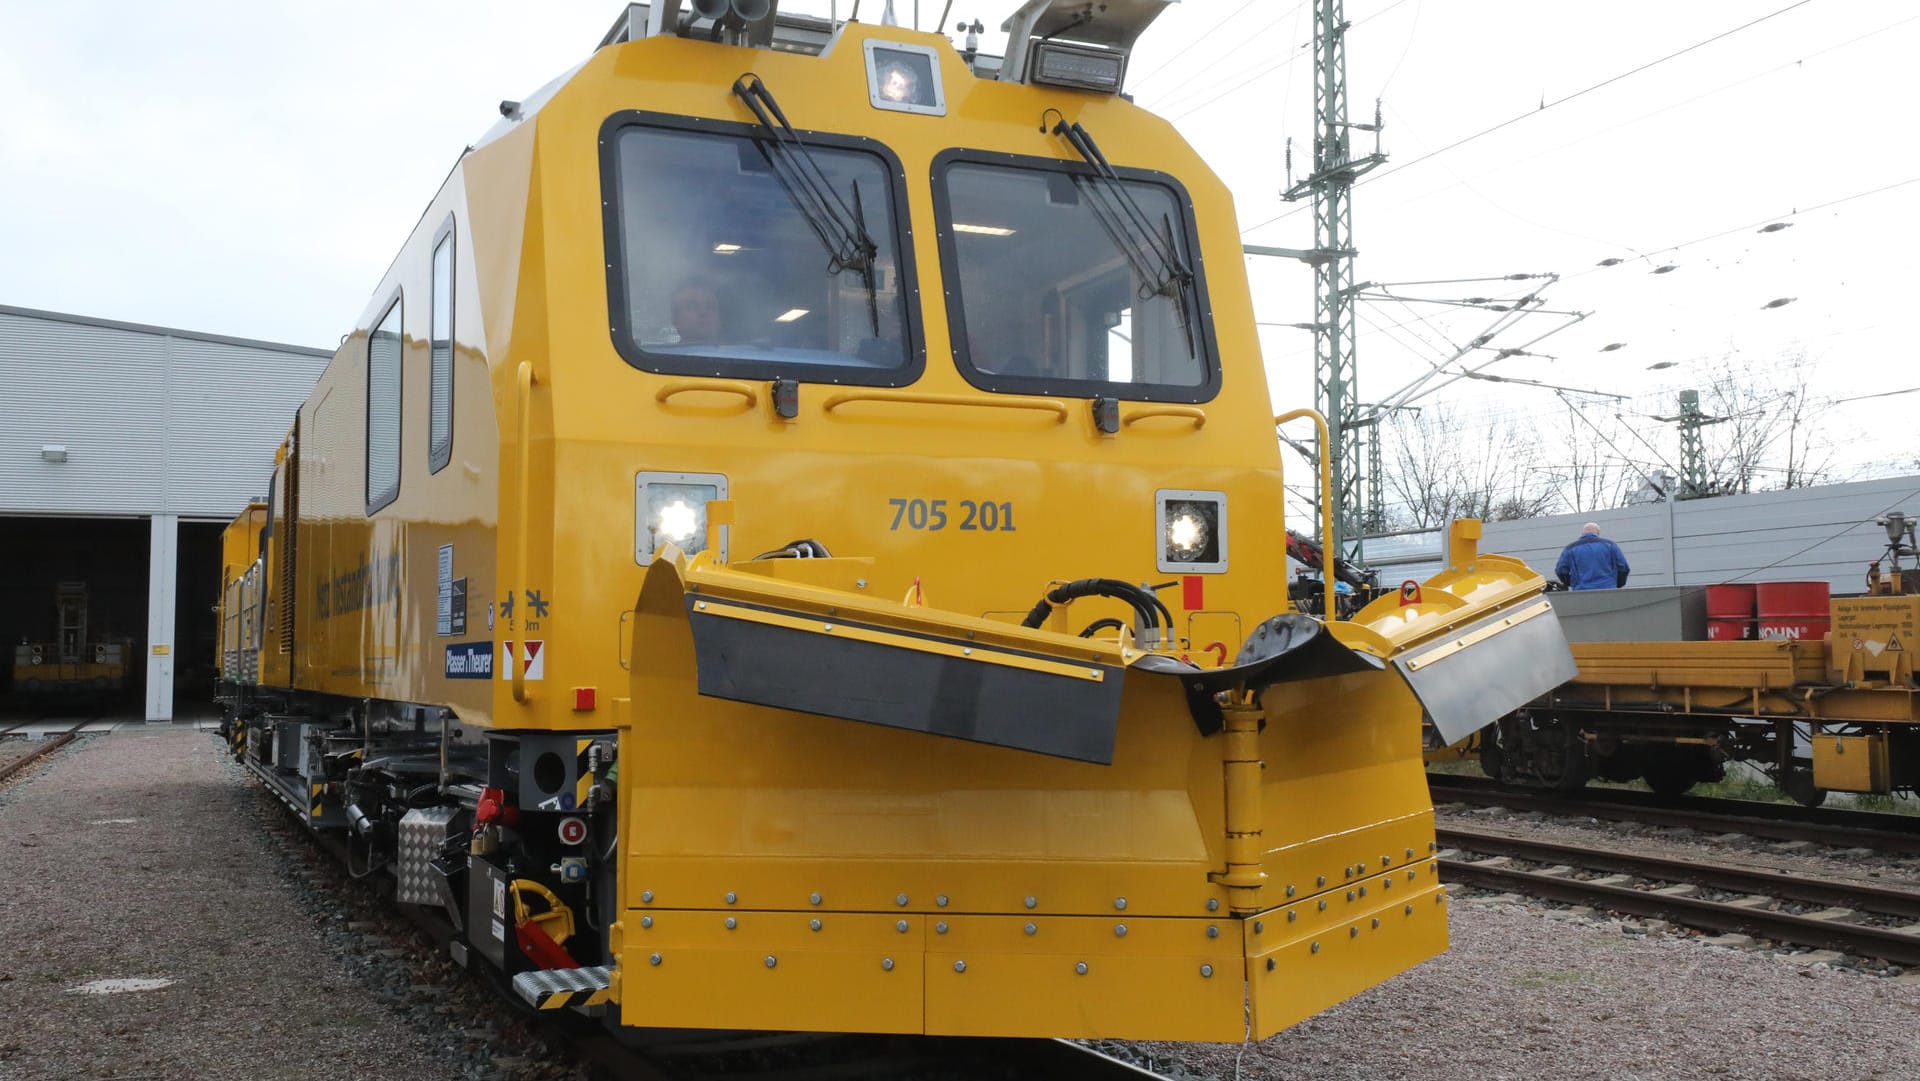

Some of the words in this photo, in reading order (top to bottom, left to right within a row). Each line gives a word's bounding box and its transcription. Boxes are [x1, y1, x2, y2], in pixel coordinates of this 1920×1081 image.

[889, 498, 947, 531] 705
[960, 500, 1016, 531] 201
[446, 649, 466, 673] Plasser
[468, 648, 493, 673] Theurer
